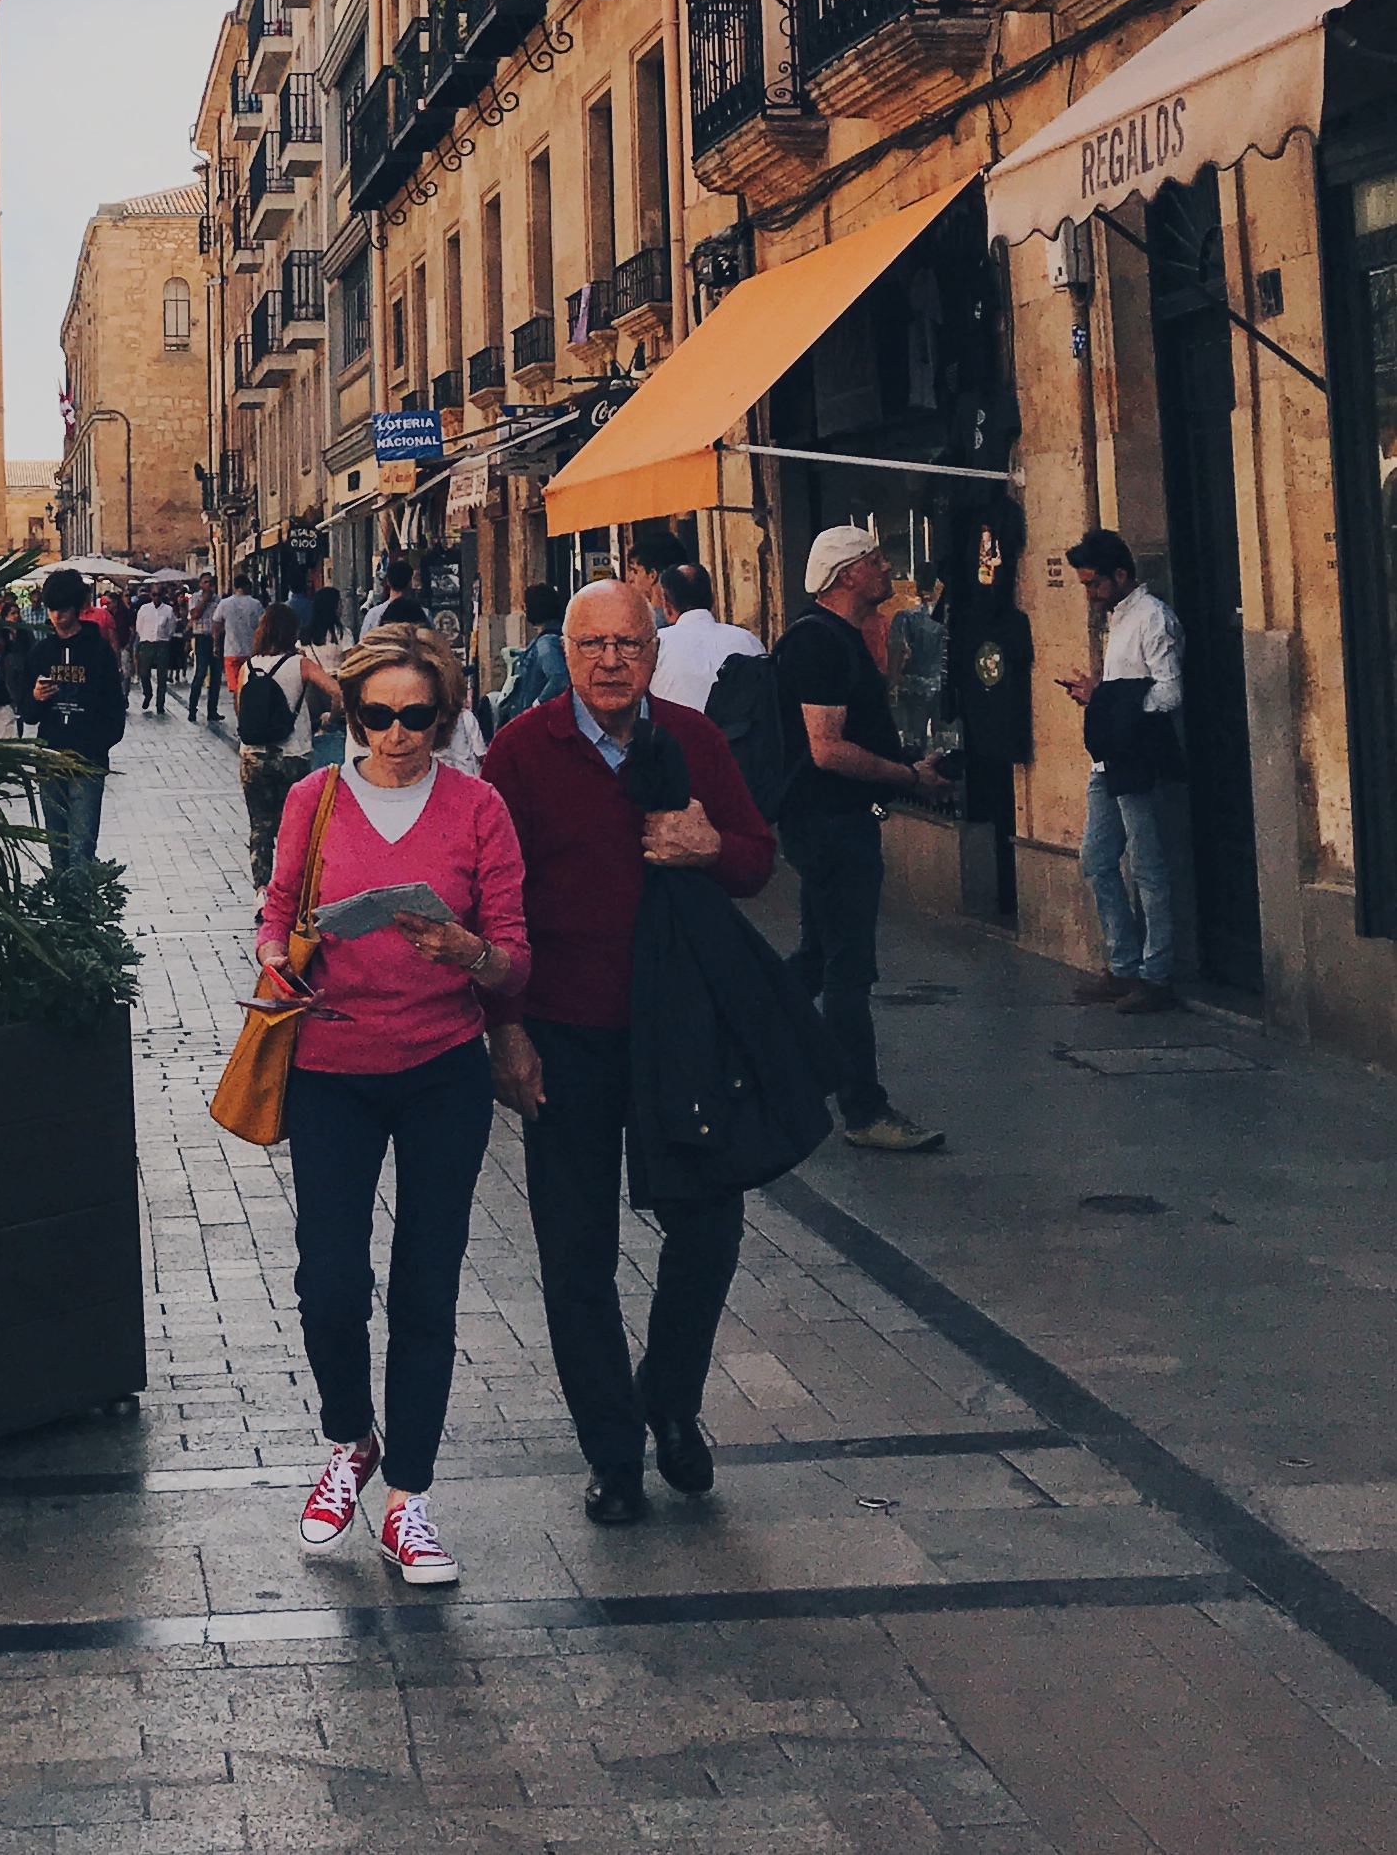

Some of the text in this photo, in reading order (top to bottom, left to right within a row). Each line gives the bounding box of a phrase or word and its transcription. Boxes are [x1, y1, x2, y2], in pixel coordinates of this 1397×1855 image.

[1081, 96, 1187, 199] REGALOS
[375, 418, 435, 431] LOTERIA
[376, 436, 440, 448] NACIONAL
